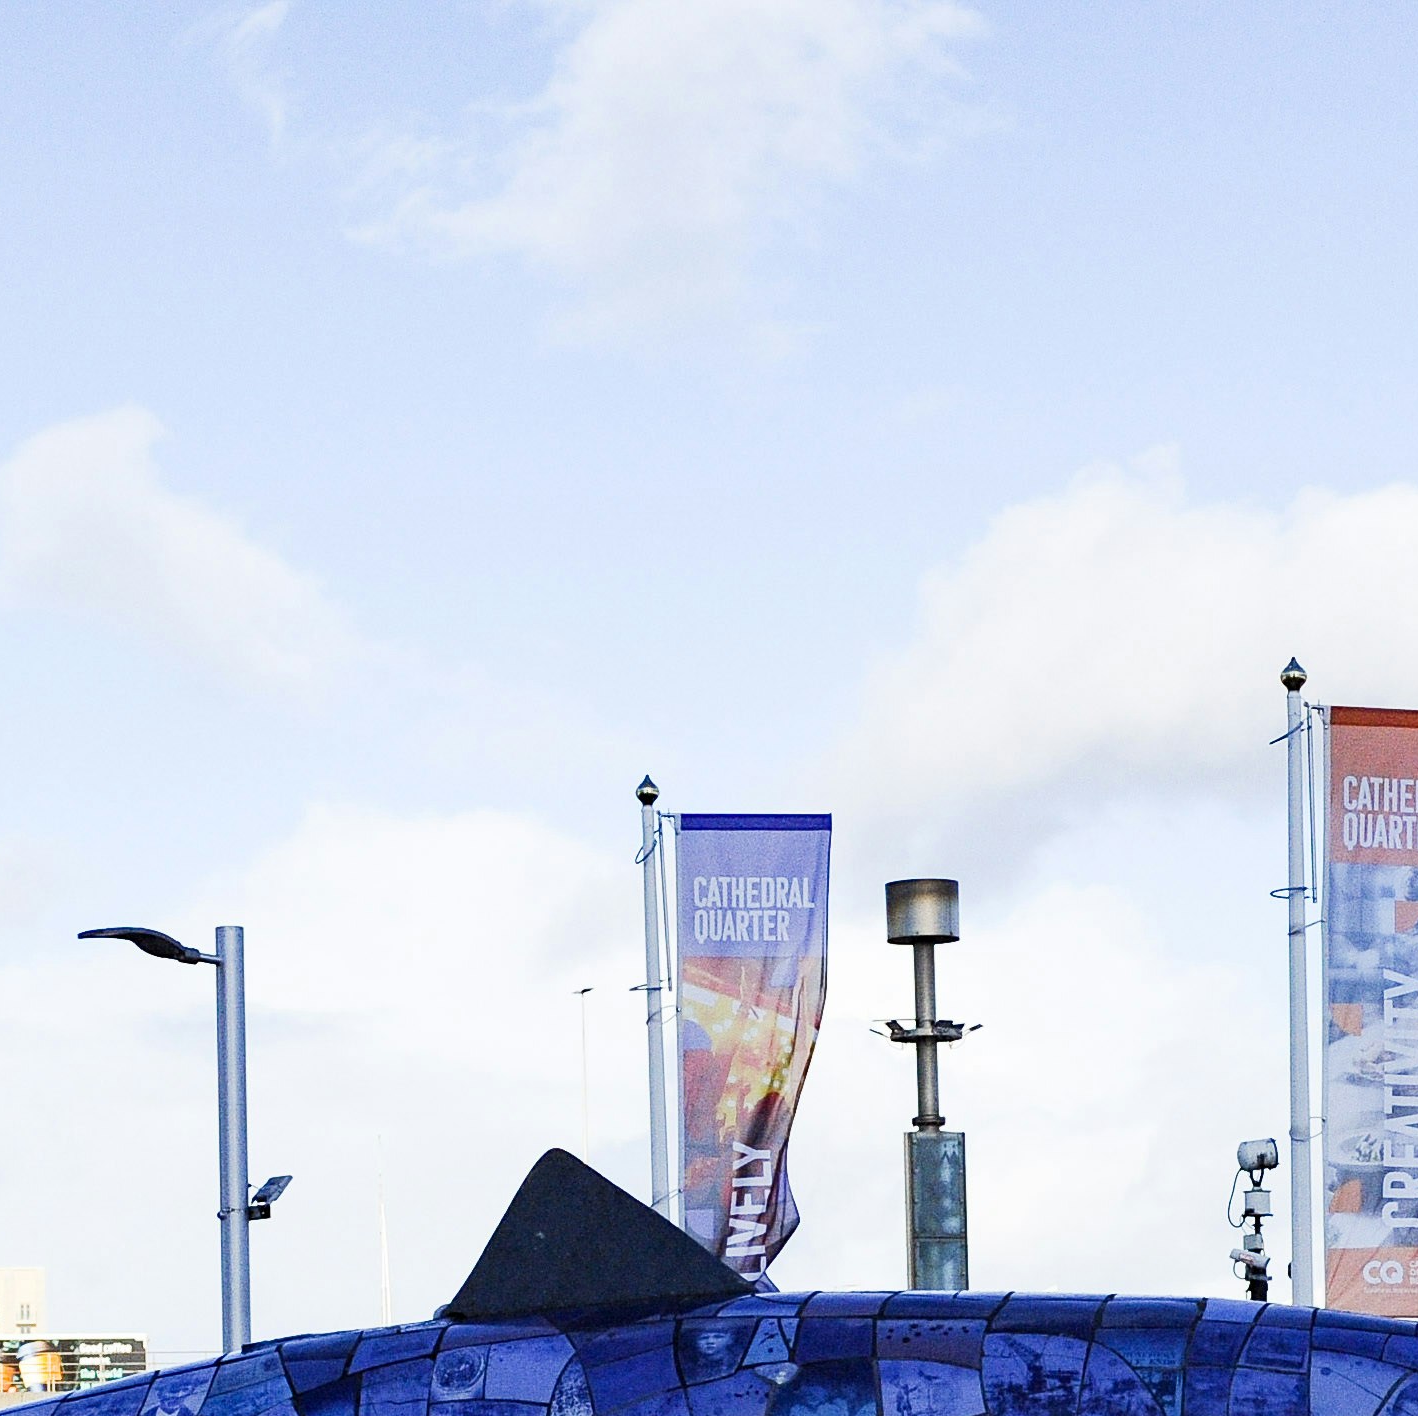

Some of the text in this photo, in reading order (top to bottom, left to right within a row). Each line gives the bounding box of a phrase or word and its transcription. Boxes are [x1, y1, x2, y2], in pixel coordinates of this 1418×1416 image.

[693, 876, 815, 909] CATHEDRAL
[694, 909, 791, 944] QUARTER
[725, 1141, 772, 1283] LIVELY
[1362, 1260, 1404, 1285] CQ
